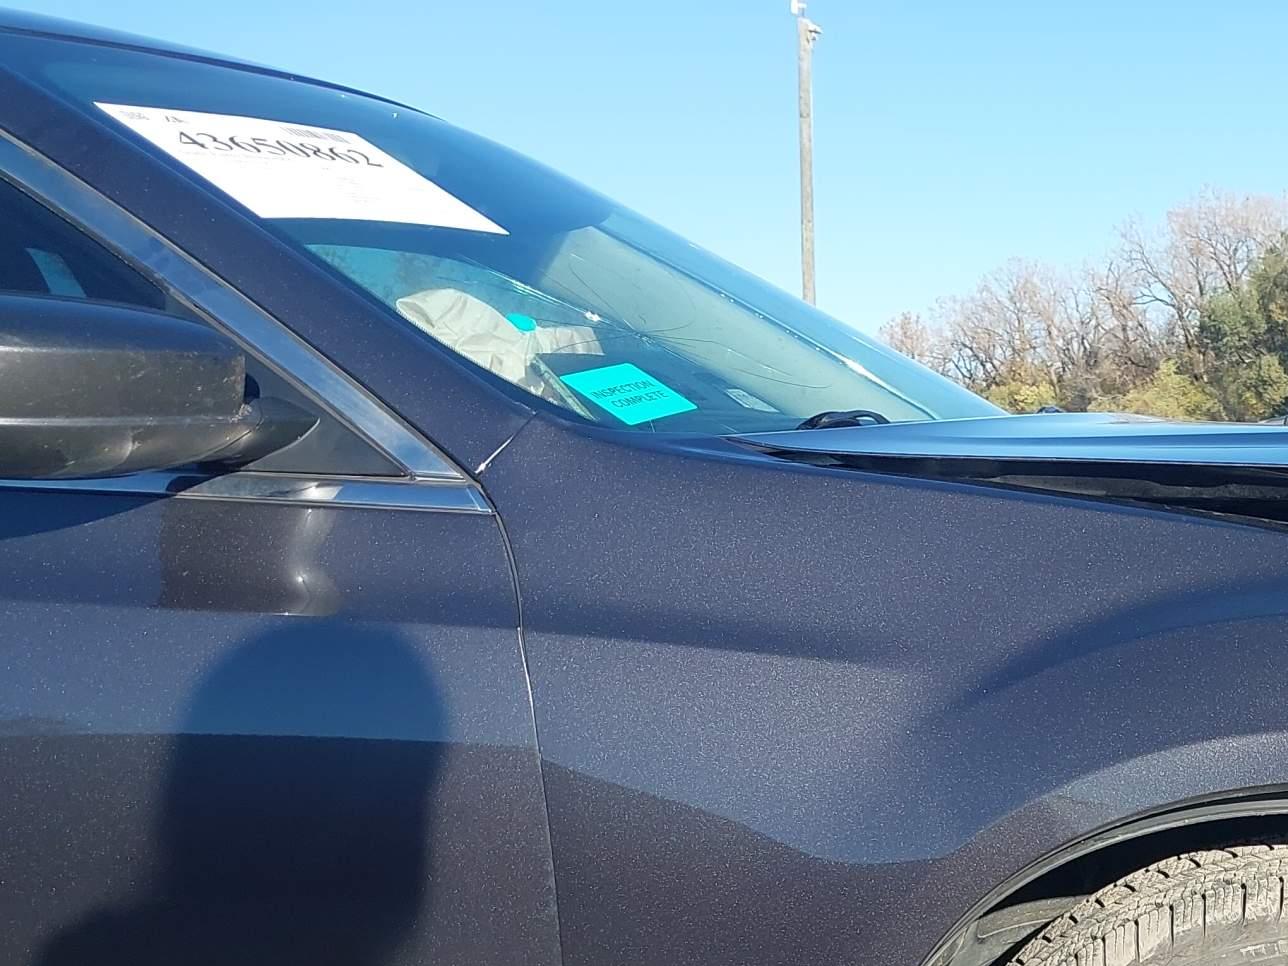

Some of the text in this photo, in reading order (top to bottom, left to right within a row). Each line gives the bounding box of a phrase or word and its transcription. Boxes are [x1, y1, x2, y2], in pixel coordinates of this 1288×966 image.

[179, 131, 384, 168] 43650862
[591, 379, 656, 399] INSPECTION
[611, 390, 669, 408] COMPLETE
